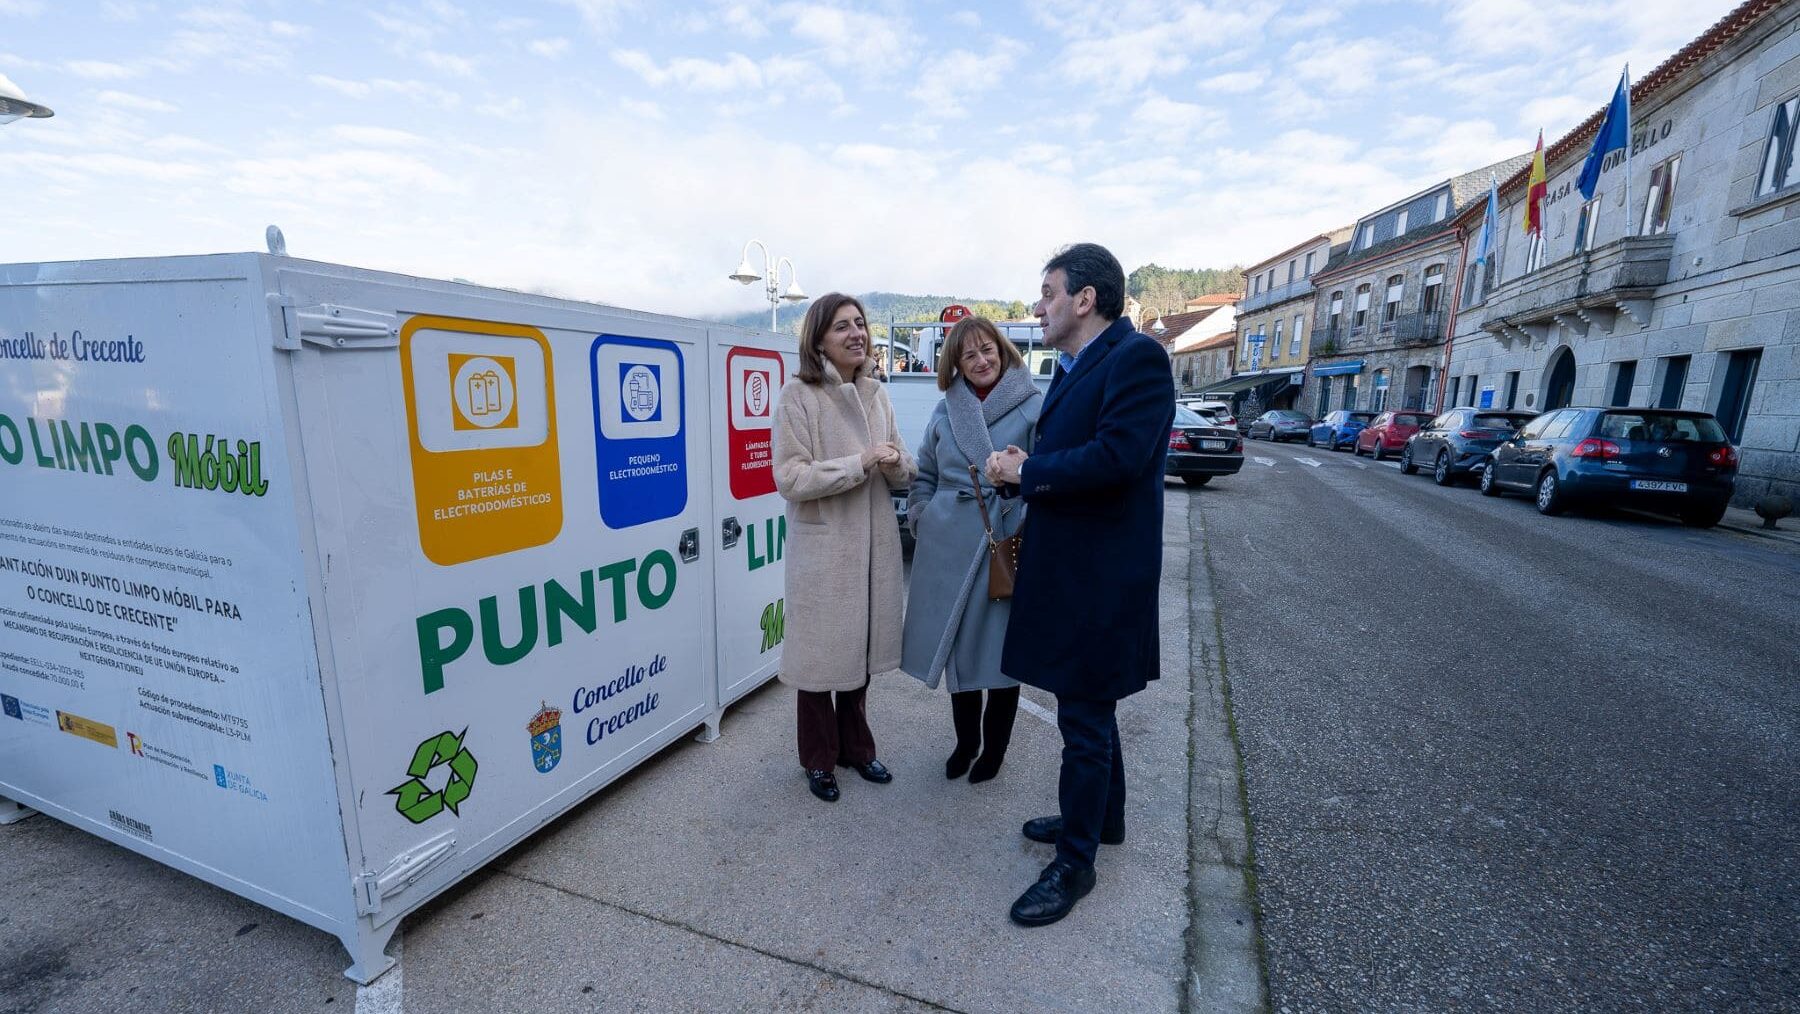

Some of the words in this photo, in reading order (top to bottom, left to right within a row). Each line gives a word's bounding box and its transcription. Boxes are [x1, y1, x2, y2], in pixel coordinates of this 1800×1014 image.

[1602, 120, 1672, 173] ONCELLO
[50, 332, 70, 360] de
[72, 330, 146, 364] Crecente
[27, 416, 160, 482] LIMPO
[168, 432, 268, 497] Móbil
[609, 463, 678, 480] ELECTRODOMÉSTICO
[473, 470, 504, 482] PILAS
[506, 469, 512, 479] E
[434, 492, 552, 520] ELECTRODOMÉSTICOS
[458, 482, 511, 500] BATERÍAS
[514, 482, 527, 493] DE
[100, 550, 126, 562] residuos
[126, 554, 134, 564] de
[135, 557, 176, 572] competencia
[122, 540, 153, 552] entidades
[154, 544, 174, 556] locais
[174, 547, 184, 557] de
[184, 549, 208, 562] Galicia
[209, 555, 226, 566] para
[227, 558, 232, 567] o
[27, 585, 36, 600] O
[38, 587, 94, 613] CONCELLO
[96, 600, 112, 617] DE
[56, 566, 80, 584] DUN
[81, 571, 120, 593] PUNTO
[122, 580, 160, 602] LIMPO
[162, 586, 204, 612] MÓBIL
[206, 598, 242, 621] PARA
[416, 548, 677, 696] PUNTO
[4, 620, 38, 636] MECANISMO
[40, 628, 48, 637] DE
[48, 630, 94, 648] RECUPERACIÓN
[144, 654, 154, 666] DE
[164, 661, 186, 674] UNIÓN
[187, 667, 220, 684] EUROPEA
[69, 622, 86, 634] Unión
[120, 636, 141, 647] través
[152, 641, 171, 656] fondo
[172, 649, 200, 664] europeo
[201, 657, 228, 672] relativo
[230, 664, 240, 674] ao
[79, 650, 144, 676] NEXTGENERATIONEU
[138, 686, 160, 702] Código
[160, 694, 168, 704] de
[573, 665, 647, 714] Concello
[648, 654, 667, 678] de
[586, 692, 660, 746] Crecente
[227, 771, 252, 786] XUNTA
[228, 780, 238, 791] DE
[239, 784, 268, 802] GALICIA
